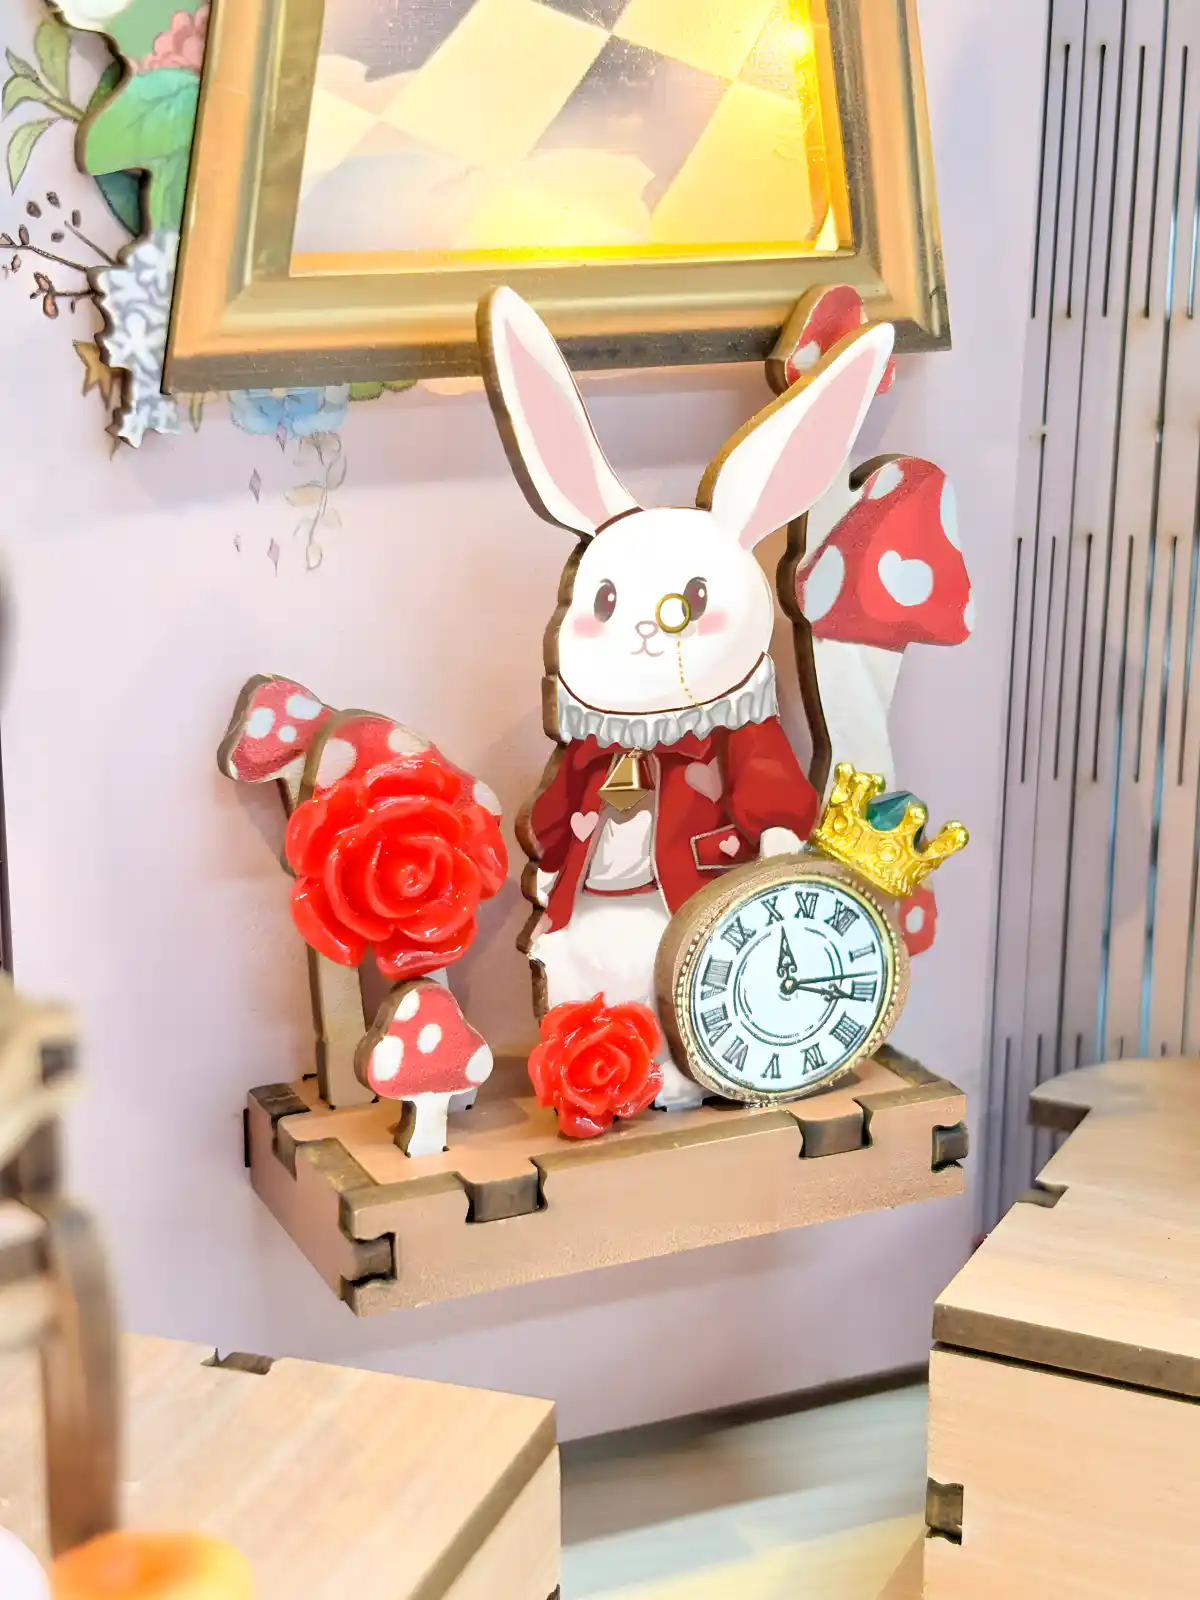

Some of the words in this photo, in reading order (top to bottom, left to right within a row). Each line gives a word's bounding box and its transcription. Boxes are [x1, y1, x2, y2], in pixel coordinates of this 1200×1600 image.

[760, 895, 784, 927] X
[793, 890, 820, 920] XI
[823, 897, 860, 937] XII
[848, 940, 876, 963] I
[760, 1052, 782, 1079] V
